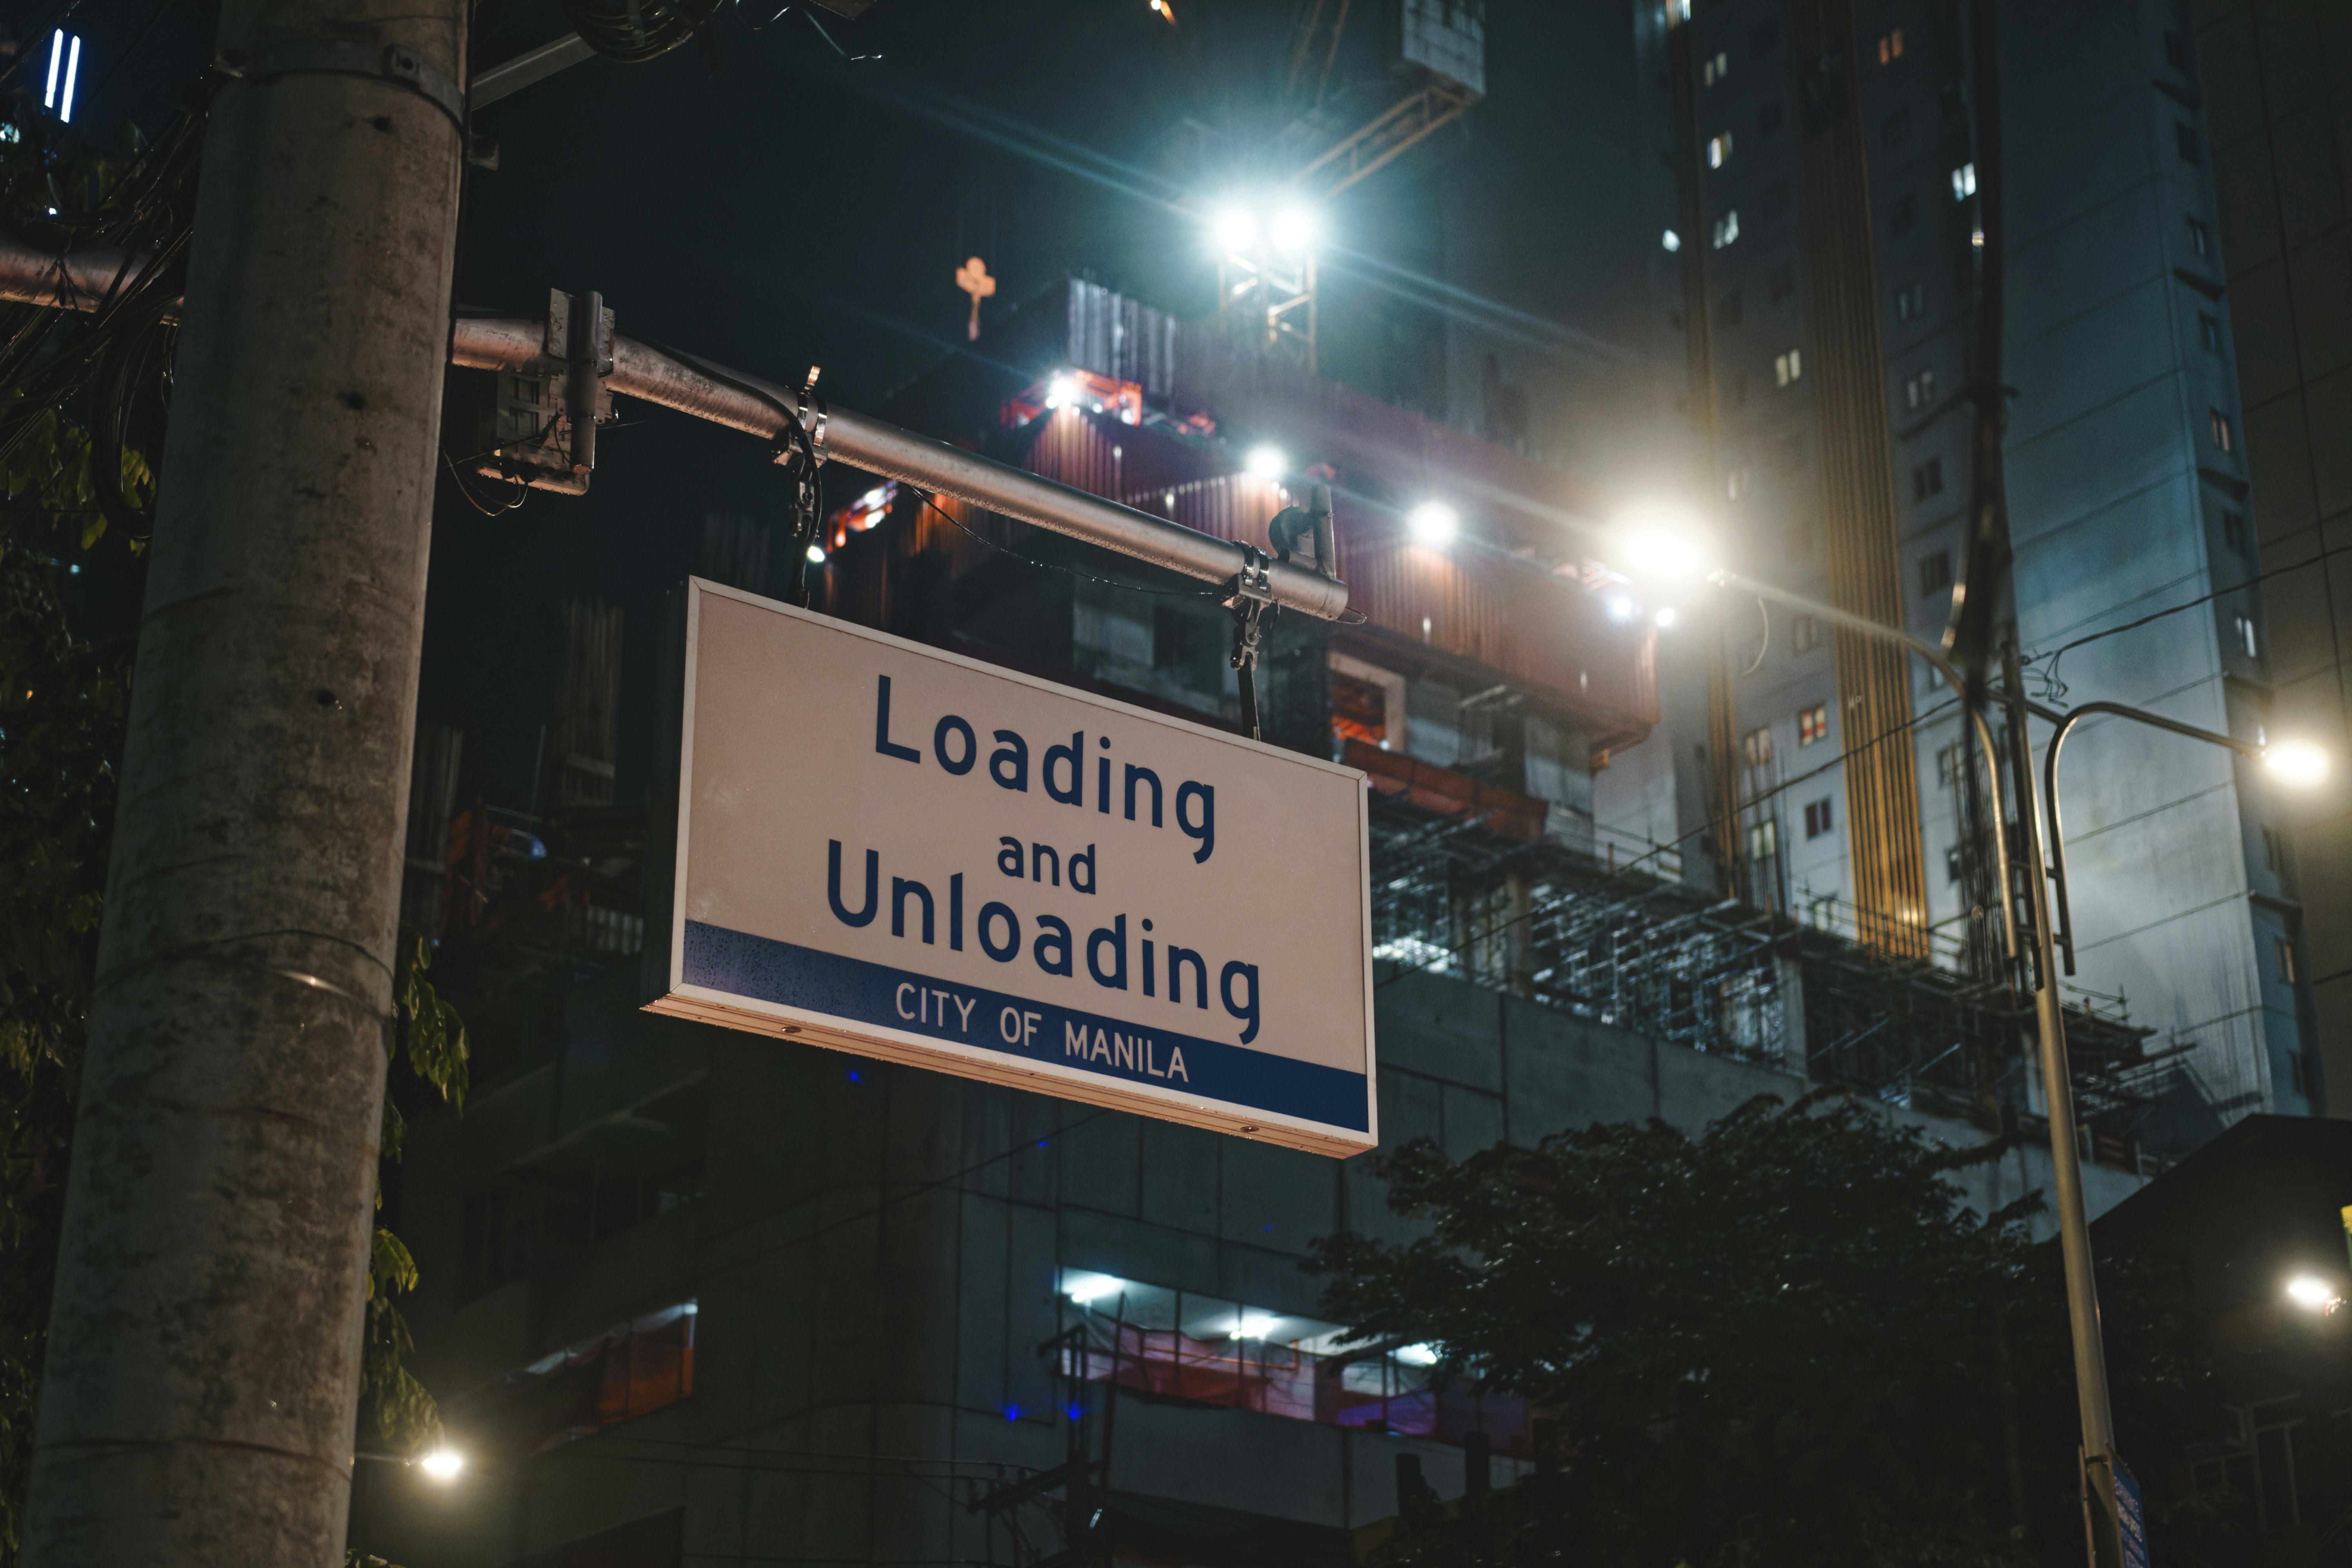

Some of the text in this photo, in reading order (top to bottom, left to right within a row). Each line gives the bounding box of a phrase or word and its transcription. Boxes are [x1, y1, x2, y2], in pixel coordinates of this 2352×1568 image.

[875, 674, 1215, 864] Loading
[997, 836, 1096, 895] and
[827, 838, 1260, 1045] Unloading
[896, 982, 1189, 1083] CITY OF MANILA
